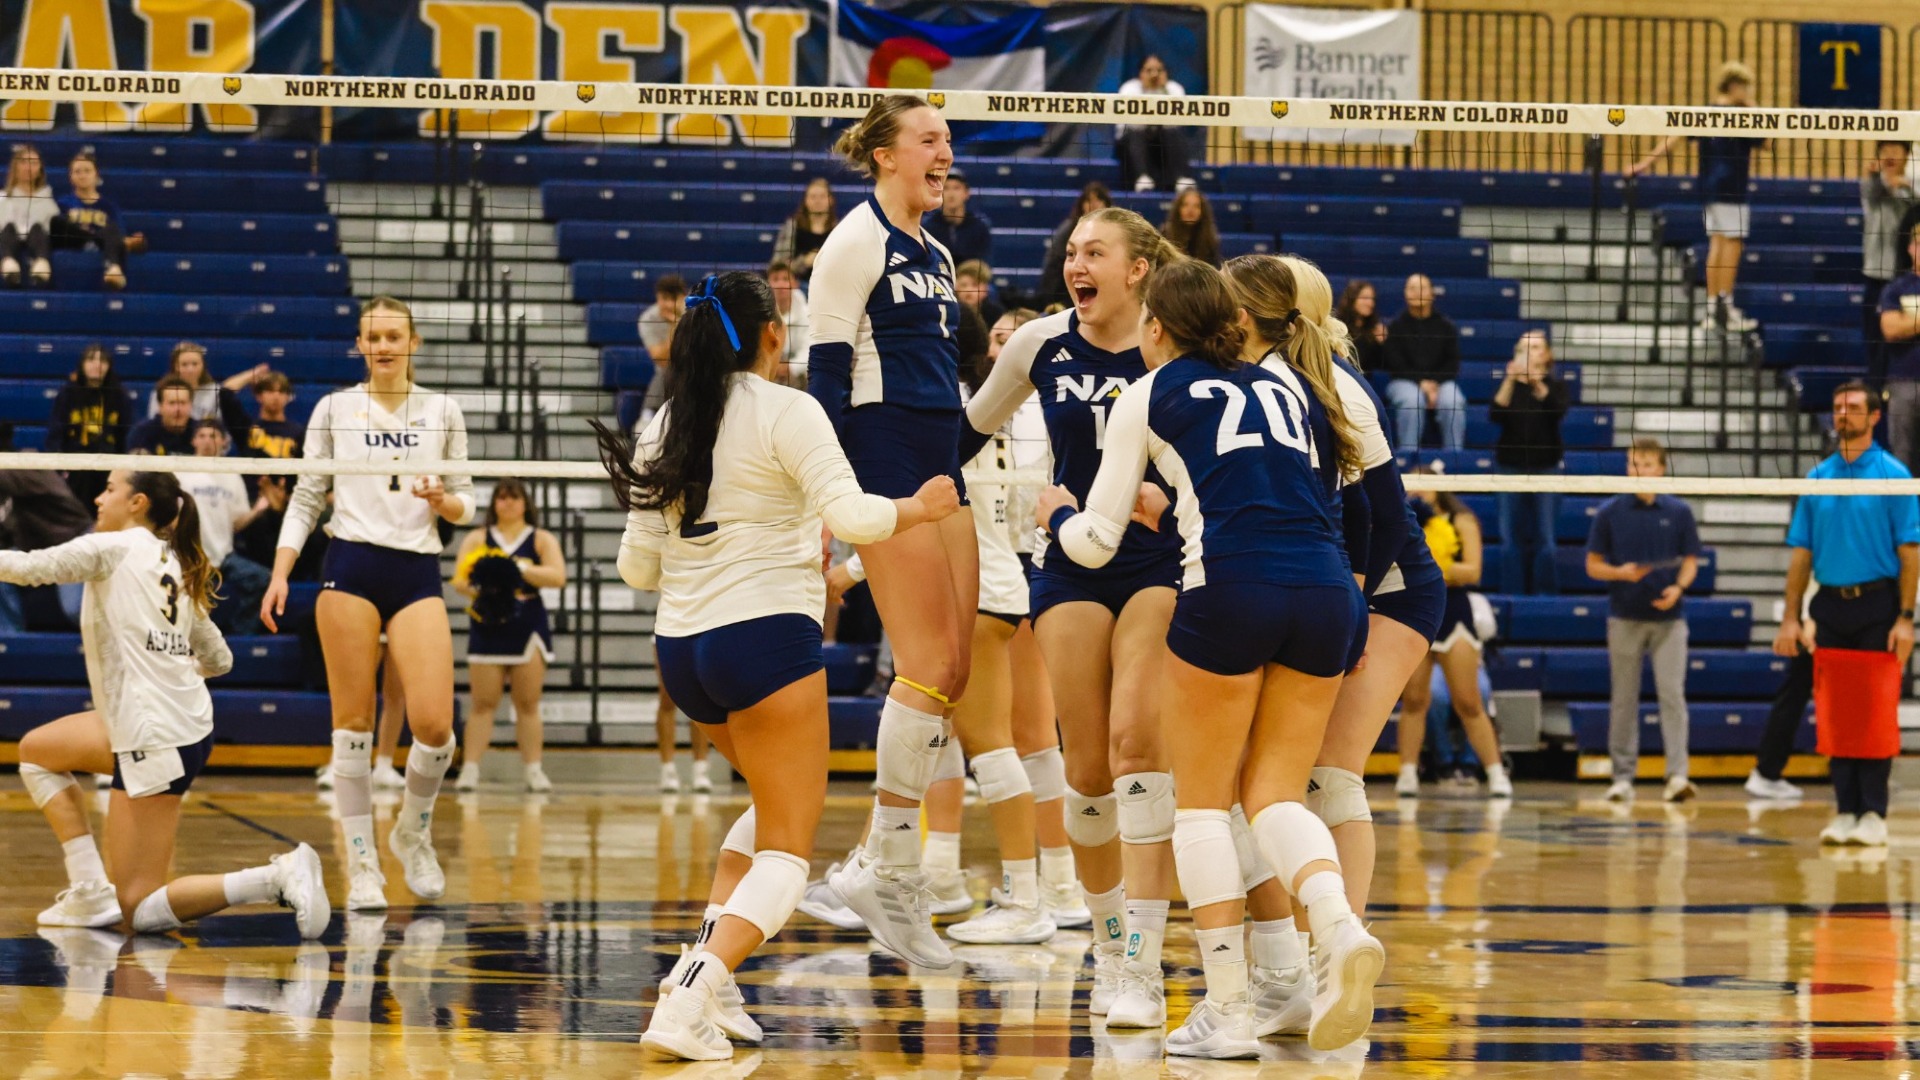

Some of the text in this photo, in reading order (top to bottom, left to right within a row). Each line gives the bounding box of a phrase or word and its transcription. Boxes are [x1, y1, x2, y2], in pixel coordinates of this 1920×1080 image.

[1294, 44, 1410, 75] Banner
[1819, 41, 1861, 91] T
[57, 75, 181, 94] COLORADO
[418, 1, 811, 147] DEN
[284, 80, 536, 102] NORTHERN COLORADO
[638, 88, 759, 107] NORTHERN
[1294, 77, 1398, 99] Health
[987, 96, 1231, 117] NORTHERN COLORADO
[1329, 104, 1569, 125] NORTHERN COLORADO
[1665, 111, 1899, 132] NORTHERN COLORADO
[937, 303, 950, 338] 1
[1055, 373, 1141, 402] NA
[1189, 378, 1310, 457] 20
[364, 432, 419, 448] UNC
[159, 572, 178, 627] 3
